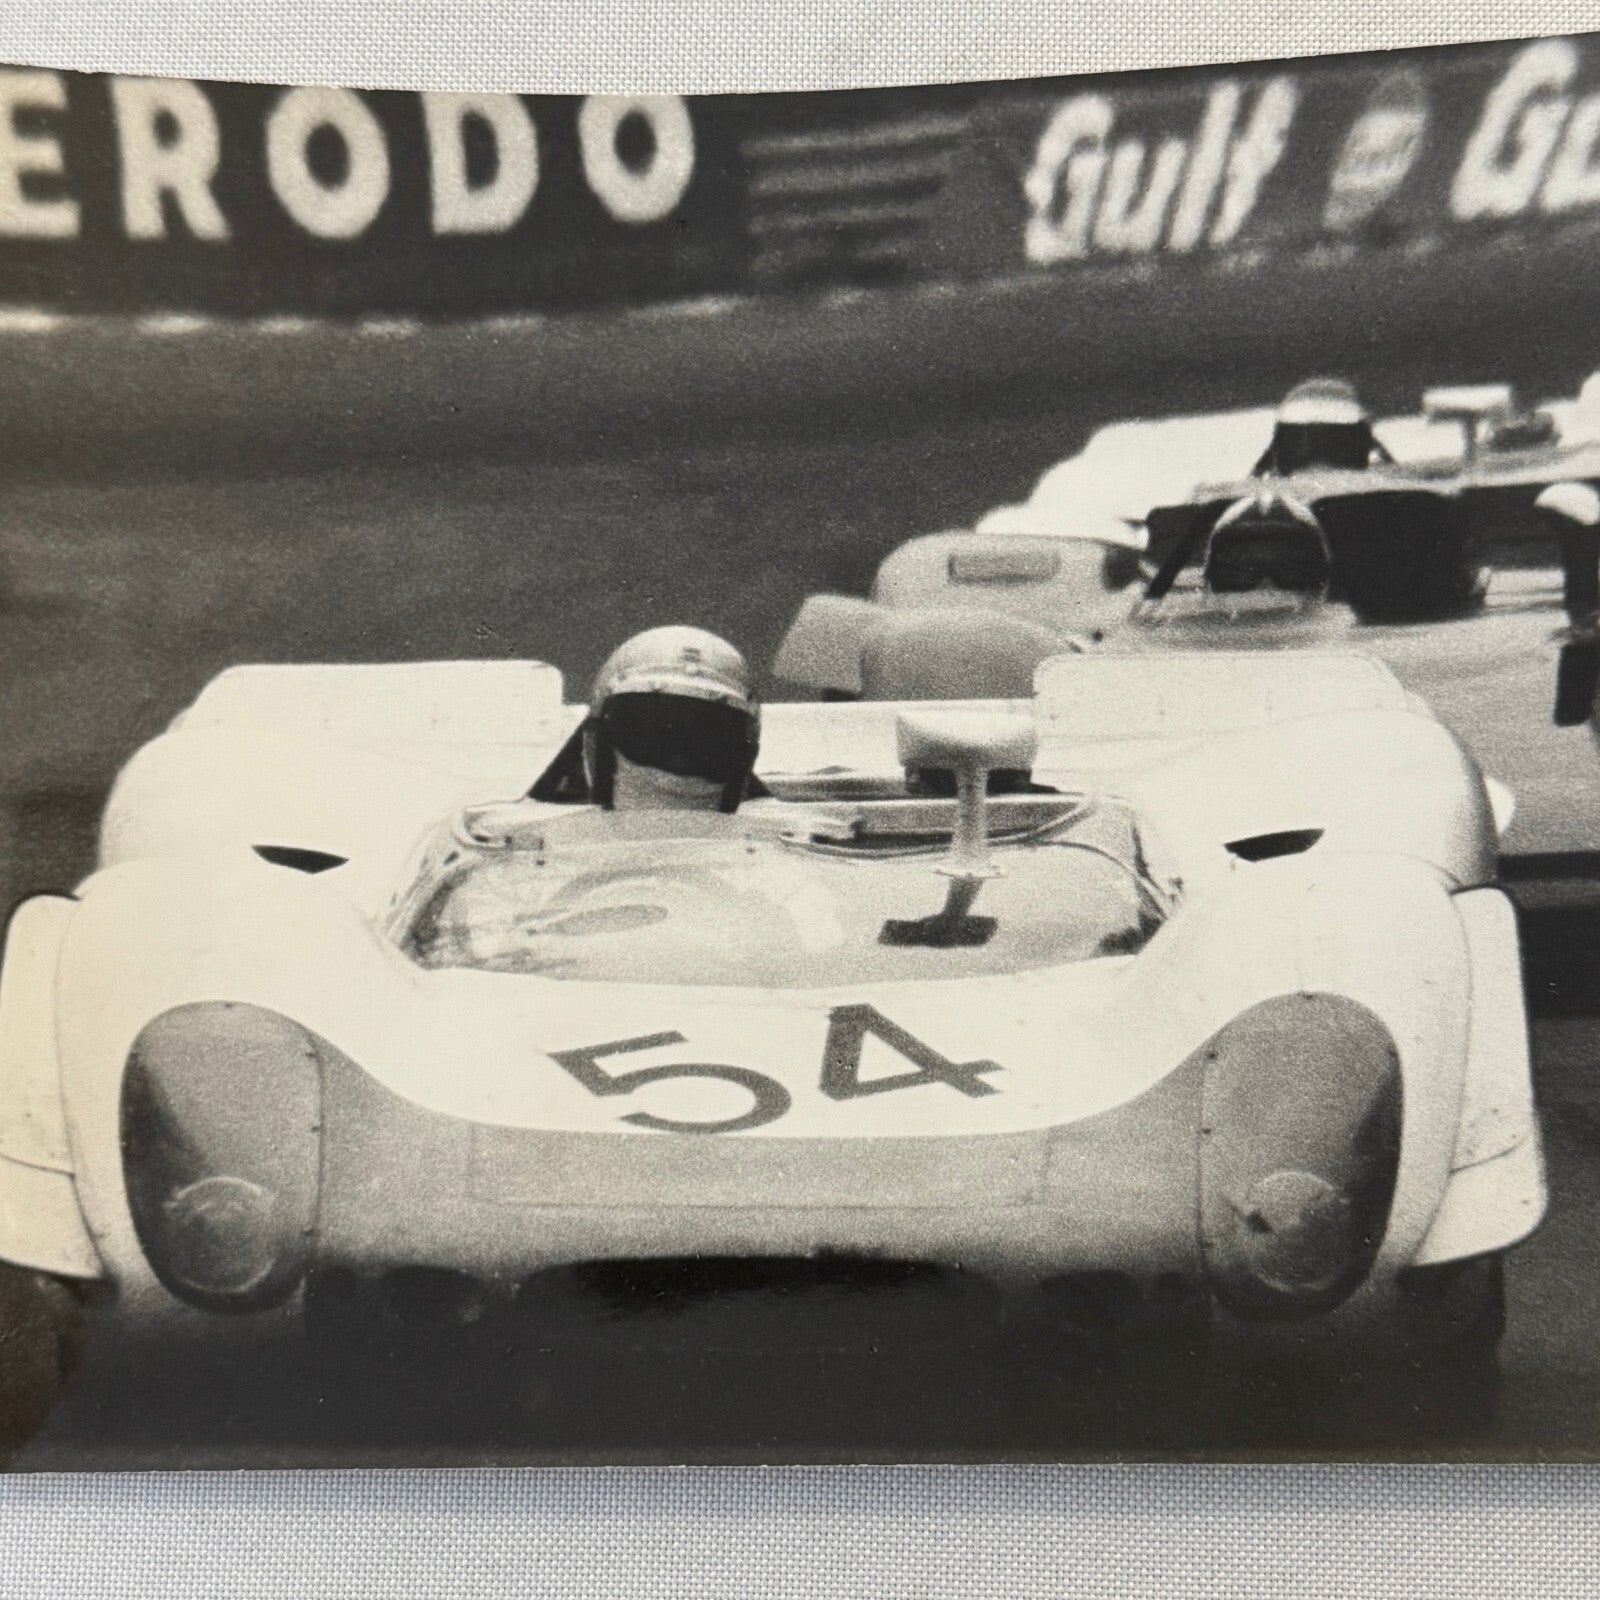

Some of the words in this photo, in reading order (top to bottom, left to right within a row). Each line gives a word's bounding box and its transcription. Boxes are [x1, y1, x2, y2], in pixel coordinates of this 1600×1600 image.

[0, 70, 697, 241] ERODO
[1023, 77, 1299, 264] Gulf
[546, 1002, 1005, 1135] 54
